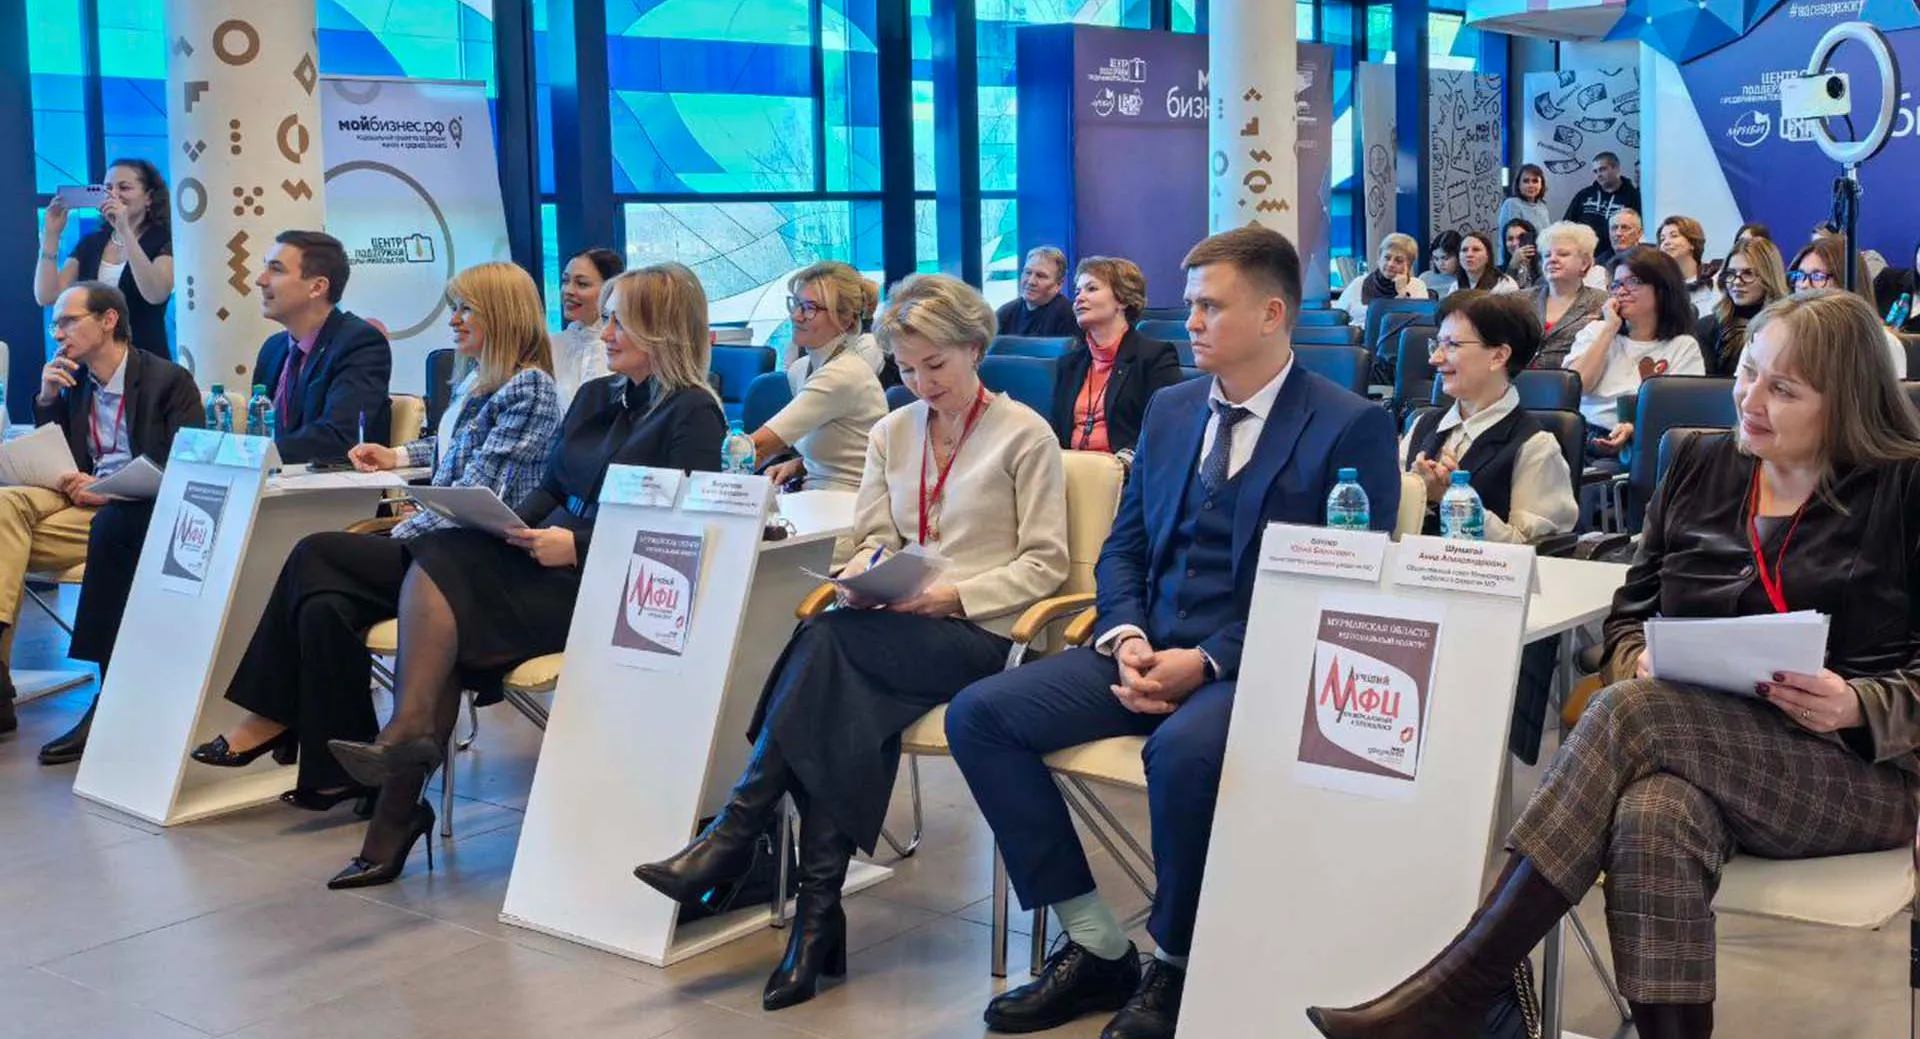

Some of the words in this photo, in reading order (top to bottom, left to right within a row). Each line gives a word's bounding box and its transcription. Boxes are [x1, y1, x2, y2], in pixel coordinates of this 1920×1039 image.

[1167, 86, 1210, 119] бизн
[338, 115, 445, 136] мойбизнес.рф
[371, 237, 403, 249] ЦЕНТР
[629, 563, 679, 610] МФЦ
[1327, 617, 1389, 632] МУРМАНСКАЯ
[1390, 623, 1430, 638] ОБЛАСТЬ
[1319, 655, 1401, 720] МФЦ
